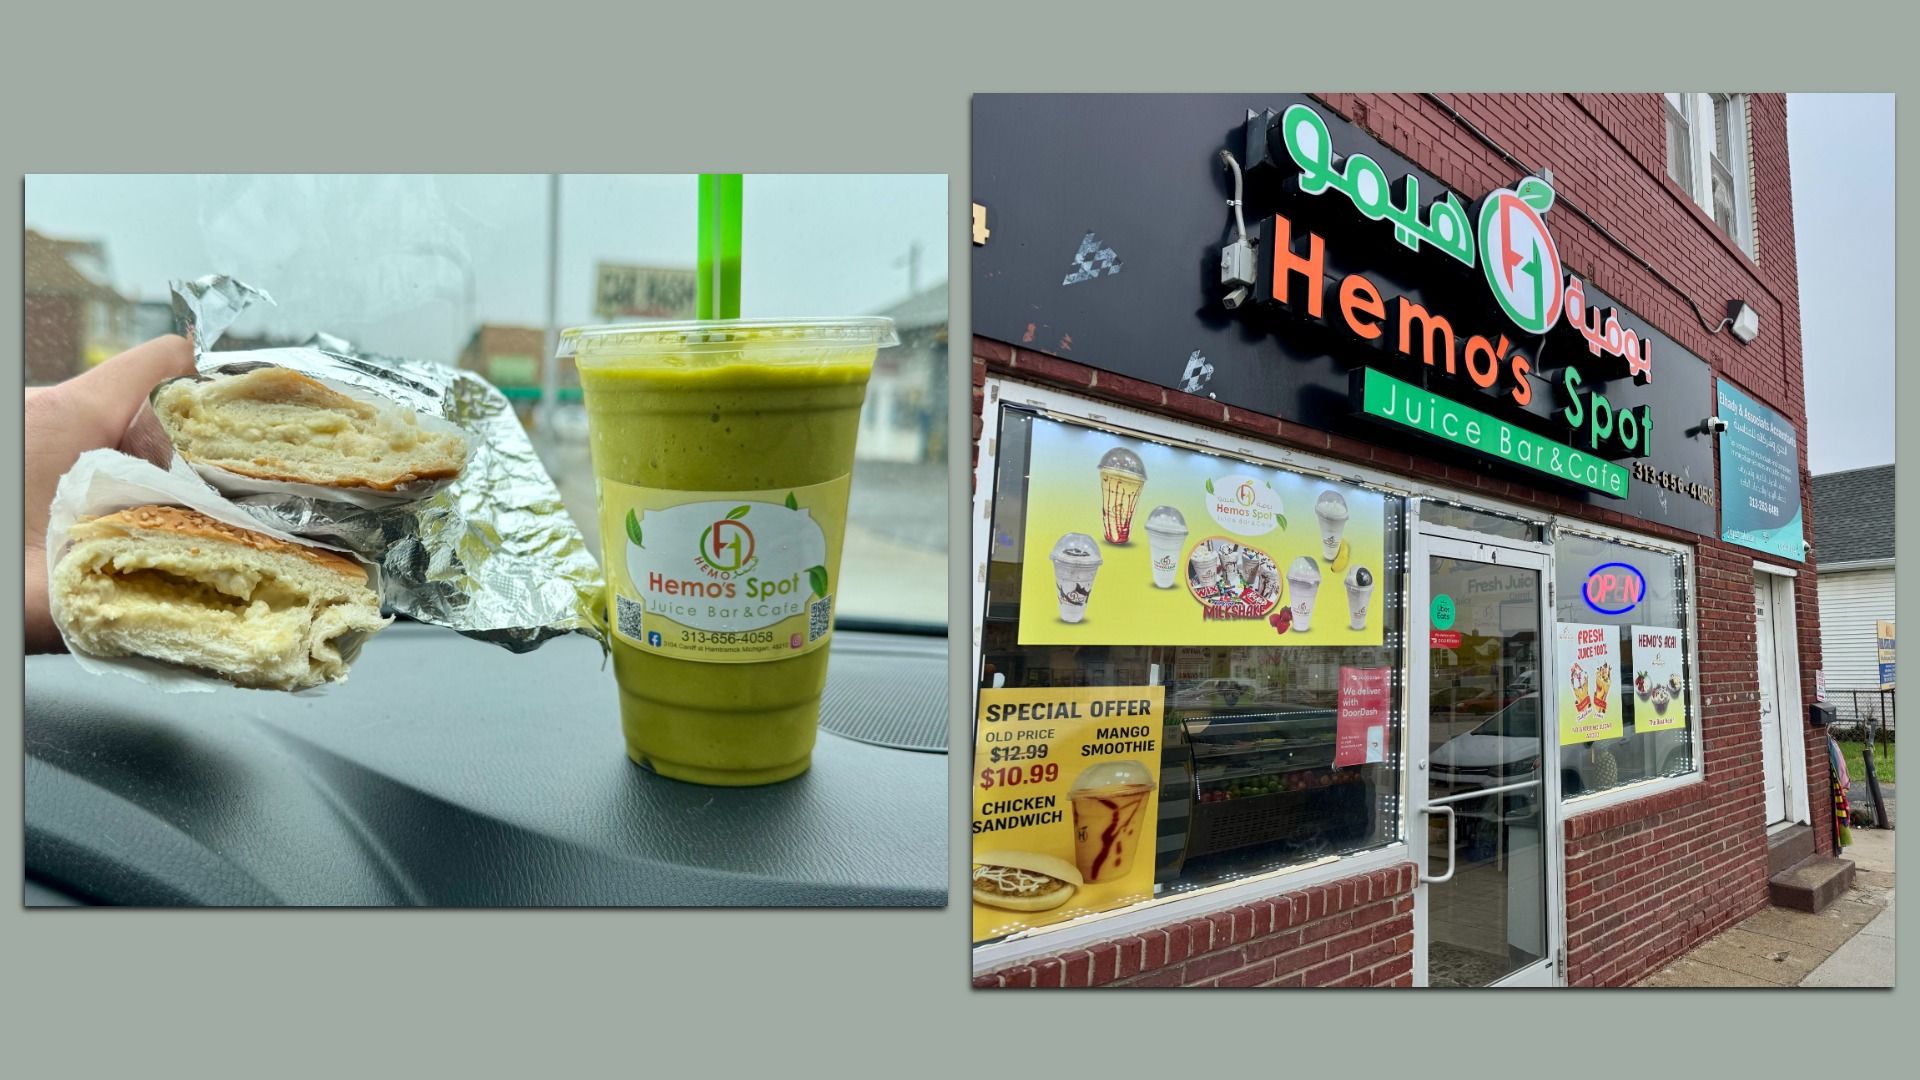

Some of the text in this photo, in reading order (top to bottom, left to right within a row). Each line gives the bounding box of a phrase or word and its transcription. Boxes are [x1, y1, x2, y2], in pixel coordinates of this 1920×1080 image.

[1272, 213, 1653, 458] Hemo's Spot
[1382, 383, 1481, 445] Juice
[1634, 461, 1714, 507] 313-656-4058
[649, 572, 799, 602] Hemo's Spot
[1468, 576, 1503, 593] Fresh
[1586, 574, 1641, 604] OPEN
[650, 600, 697, 617] Juice
[1203, 604, 1265, 621] MILKSHAKE
[681, 631, 774, 645] 313-656-4058
[1578, 628, 1604, 645] FRESH
[1638, 634, 1677, 649] HEMO'S ACAI
[1577, 646, 1593, 660] JUICE
[1343, 687, 1381, 696] We deliver
[986, 700, 1151, 722] SPECIAL OFFER
[1342, 699, 1359, 707] with
[1342, 708, 1378, 717] DoorDash
[986, 729, 1055, 742] OLD PRICE
[1096, 726, 1150, 740] MANGO
[990, 744, 1048, 763] $12.99
[1081, 740, 1155, 757] SMOOTHIE
[980, 763, 1059, 790] $10.99
[982, 795, 1056, 816] CHICKEN
[972, 811, 1063, 834] SANDWICH
